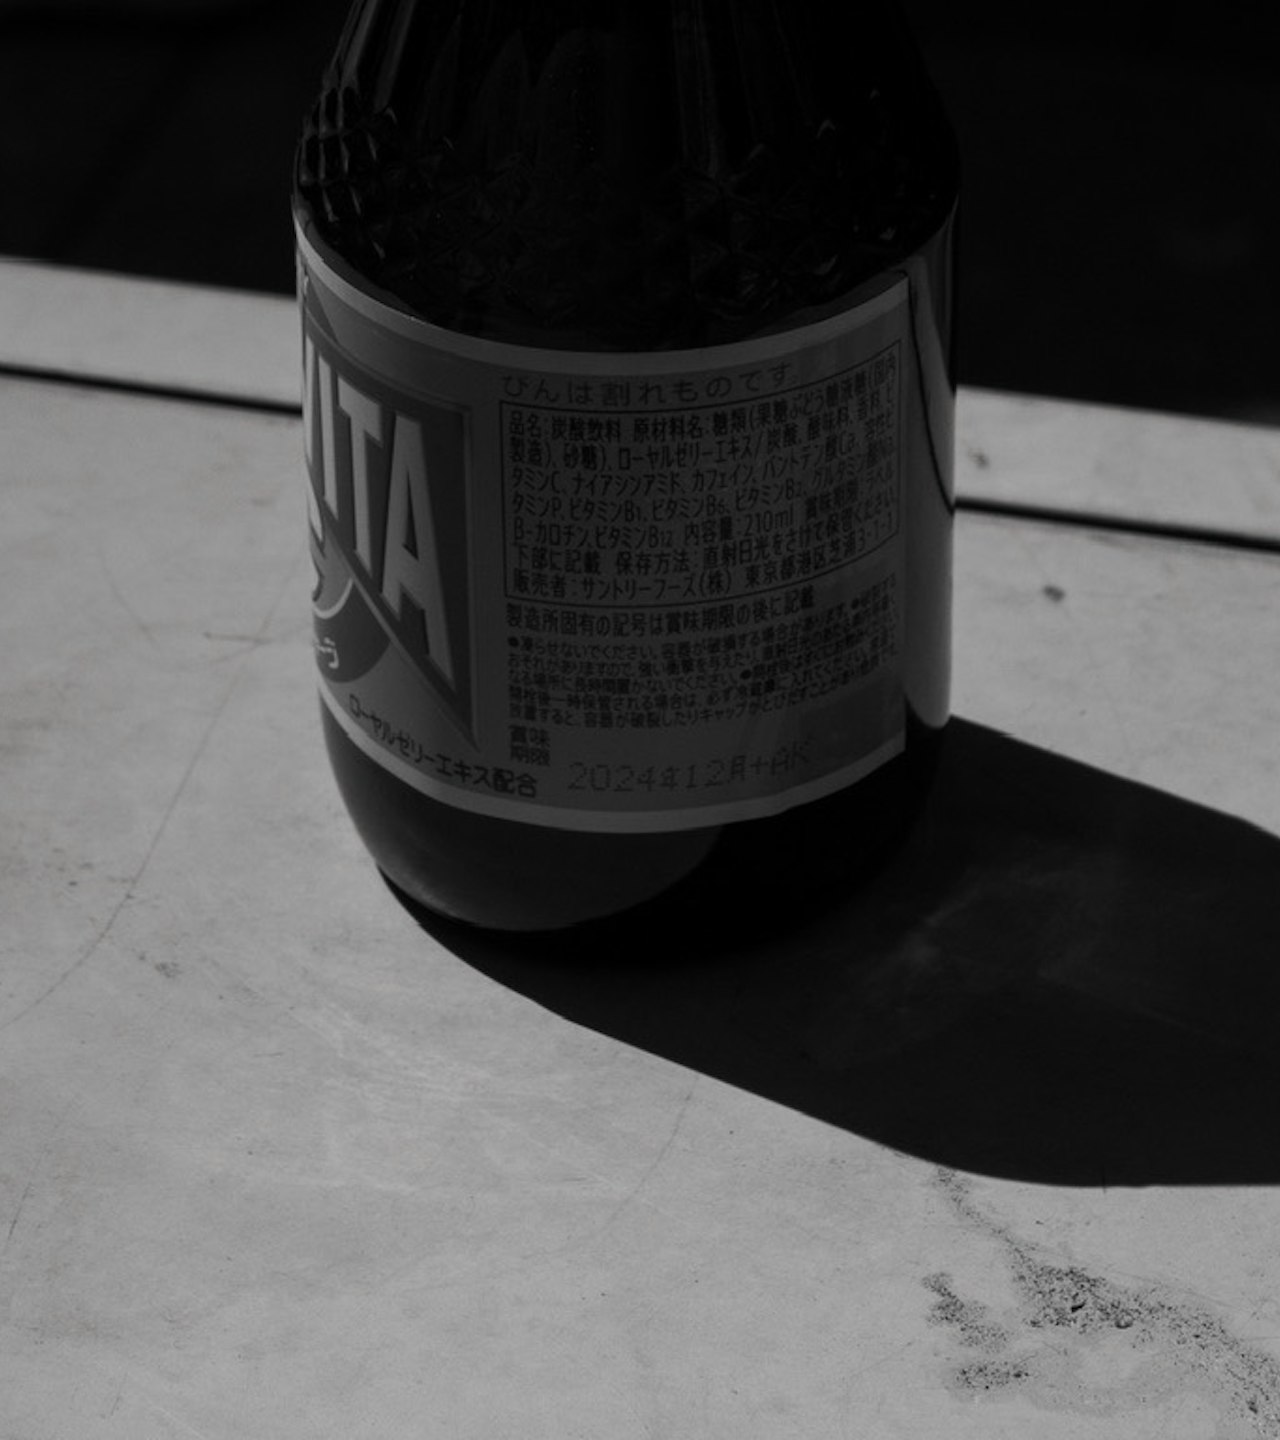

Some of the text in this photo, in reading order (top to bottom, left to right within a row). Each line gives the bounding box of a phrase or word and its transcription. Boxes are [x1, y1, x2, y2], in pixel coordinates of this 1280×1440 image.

[511, 541, 600, 575] 下部に記載
[348, 693, 539, 798] ローヤルゼリーエキス配合
[509, 725, 551, 747] 賞味
